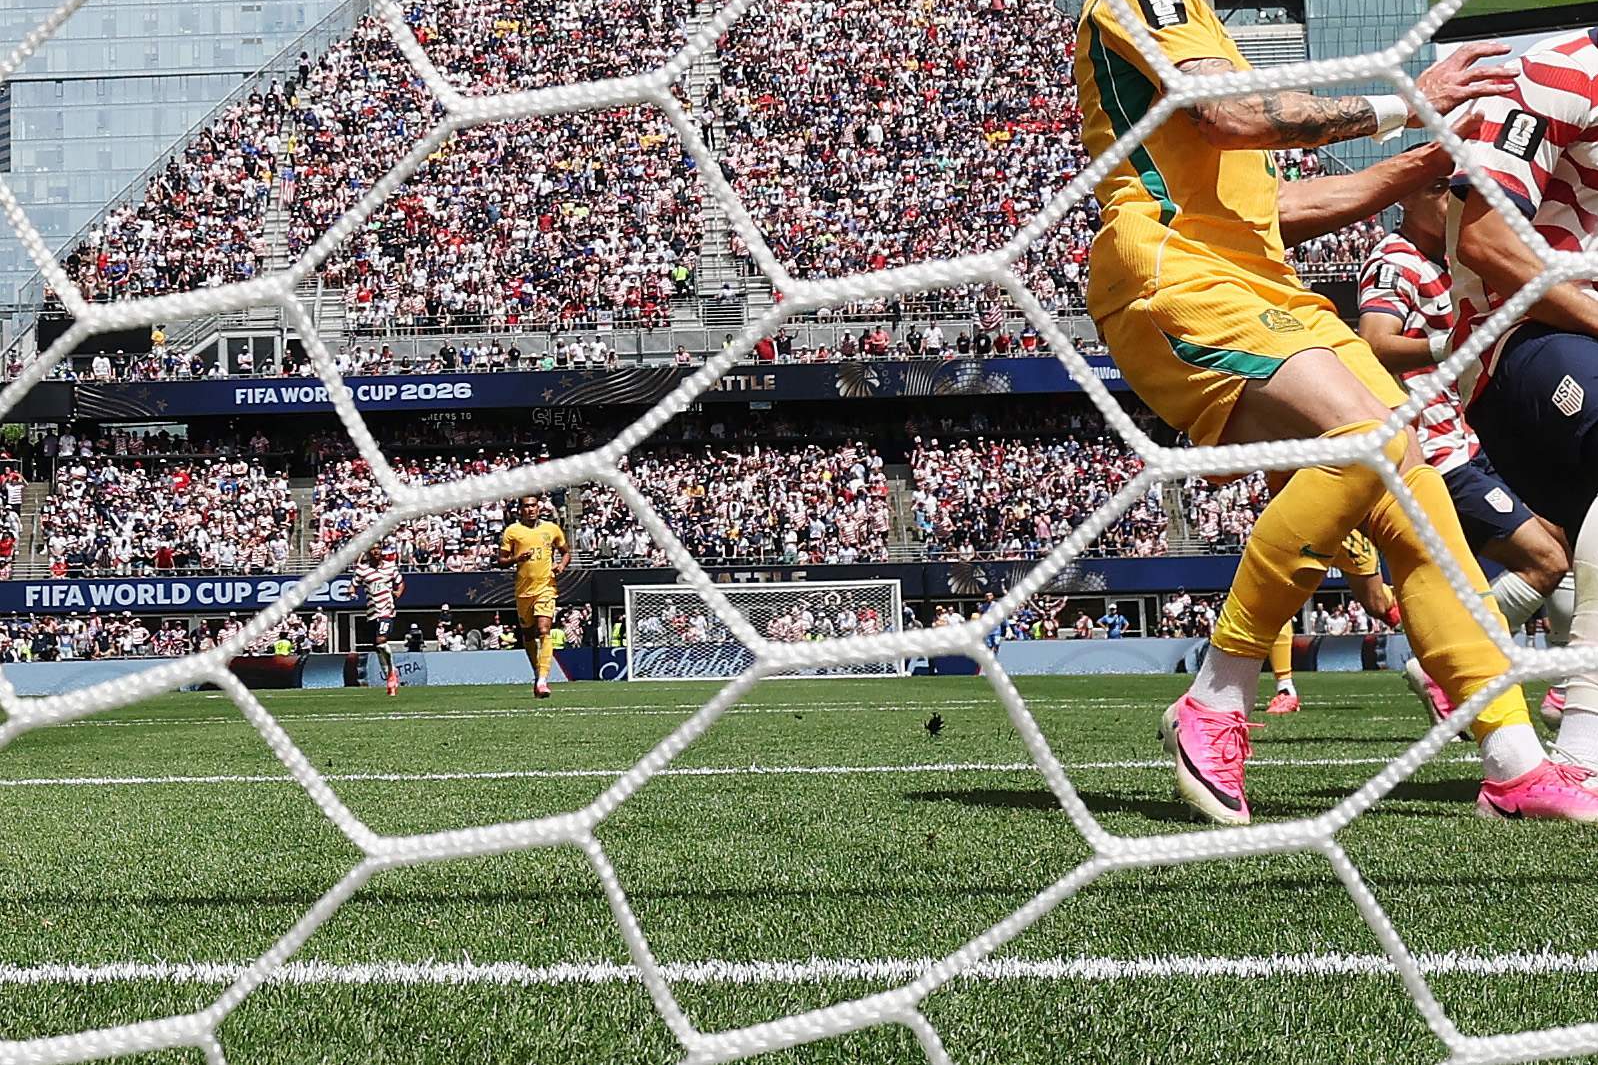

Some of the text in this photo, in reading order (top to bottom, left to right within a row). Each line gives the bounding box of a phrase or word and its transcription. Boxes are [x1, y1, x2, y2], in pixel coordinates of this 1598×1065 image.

[235, 388, 279, 405] FIFA
[357, 385, 397, 401] CUP
[400, 383, 473, 400] 2026
[1554, 379, 1572, 404] USA
[25, 585, 82, 607] FIFA
[89, 582, 186, 606] WORLD
[190, 582, 252, 604] CUP
[379, 661, 421, 681] UTRA
